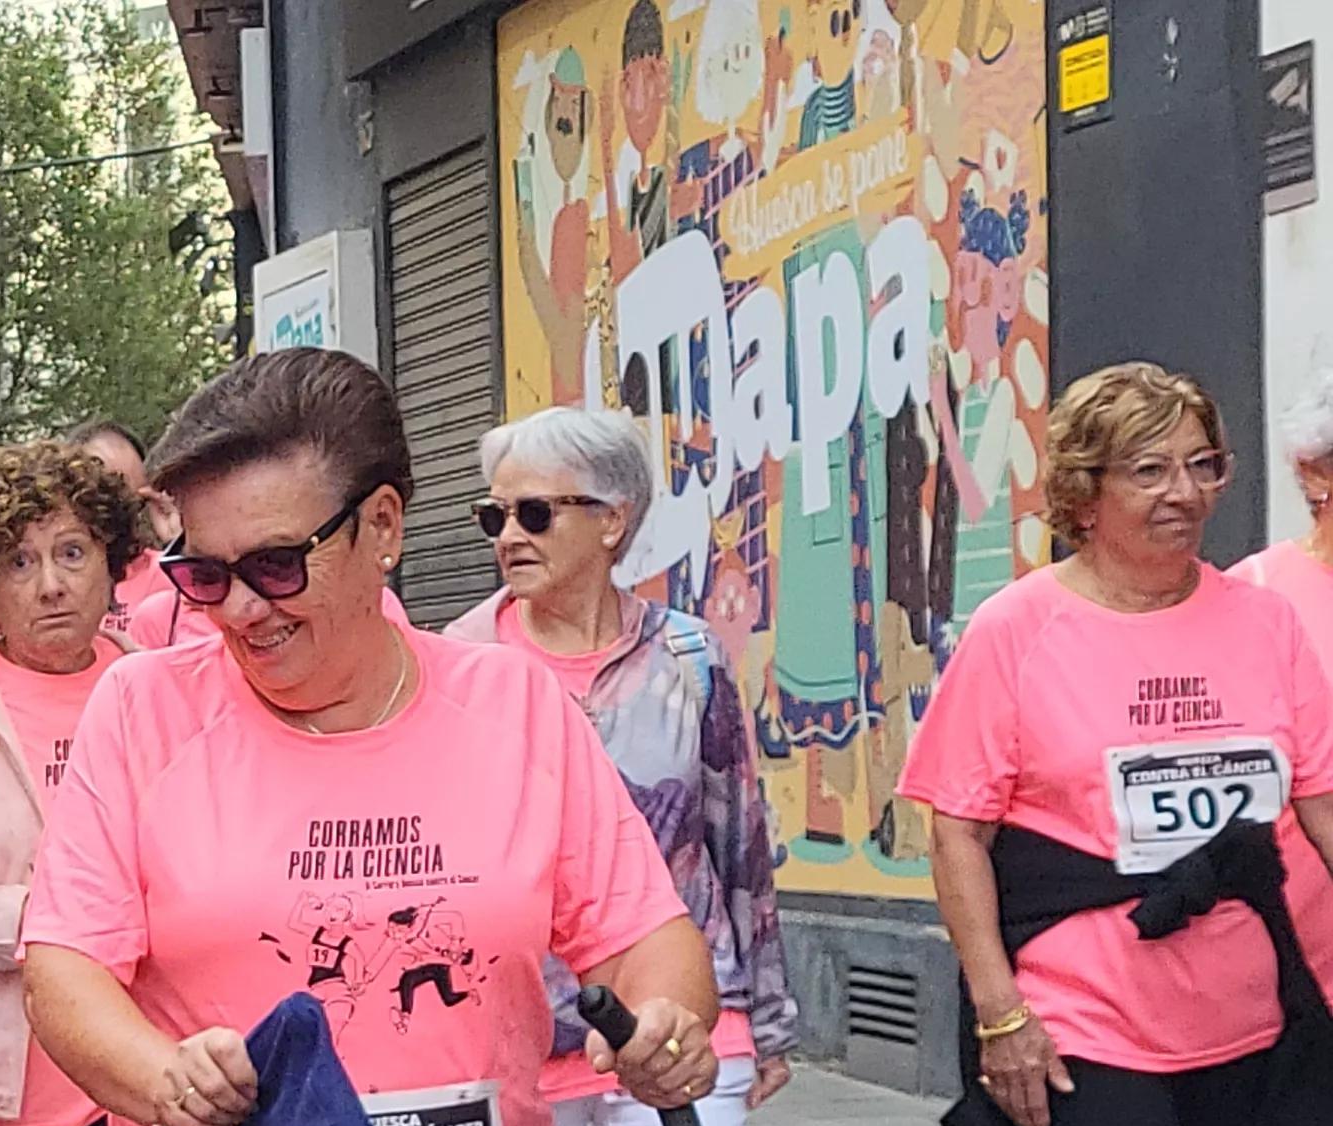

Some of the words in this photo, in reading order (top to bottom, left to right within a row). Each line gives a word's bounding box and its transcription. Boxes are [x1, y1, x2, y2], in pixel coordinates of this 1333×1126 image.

[727, 180, 818, 258] Huesca
[821, 158, 845, 213] se
[849, 127, 908, 216] pone
[614, 214, 932, 597] Tapa
[1138, 676, 1208, 701] CORRAMOS
[1128, 704, 1151, 727] POR
[1154, 703, 1167, 725] LA
[1172, 698, 1224, 724] CIENCIA
[1129, 766, 1190, 784] CONTRA
[1192, 765, 1207, 779] EL
[1212, 757, 1273, 777] CÁNCER
[1151, 782, 1254, 832] 502
[308, 815, 422, 848] CORRAMOS
[288, 849, 327, 881] POR
[333, 848, 354, 879] LA
[362, 844, 444, 879] CIENCIA
